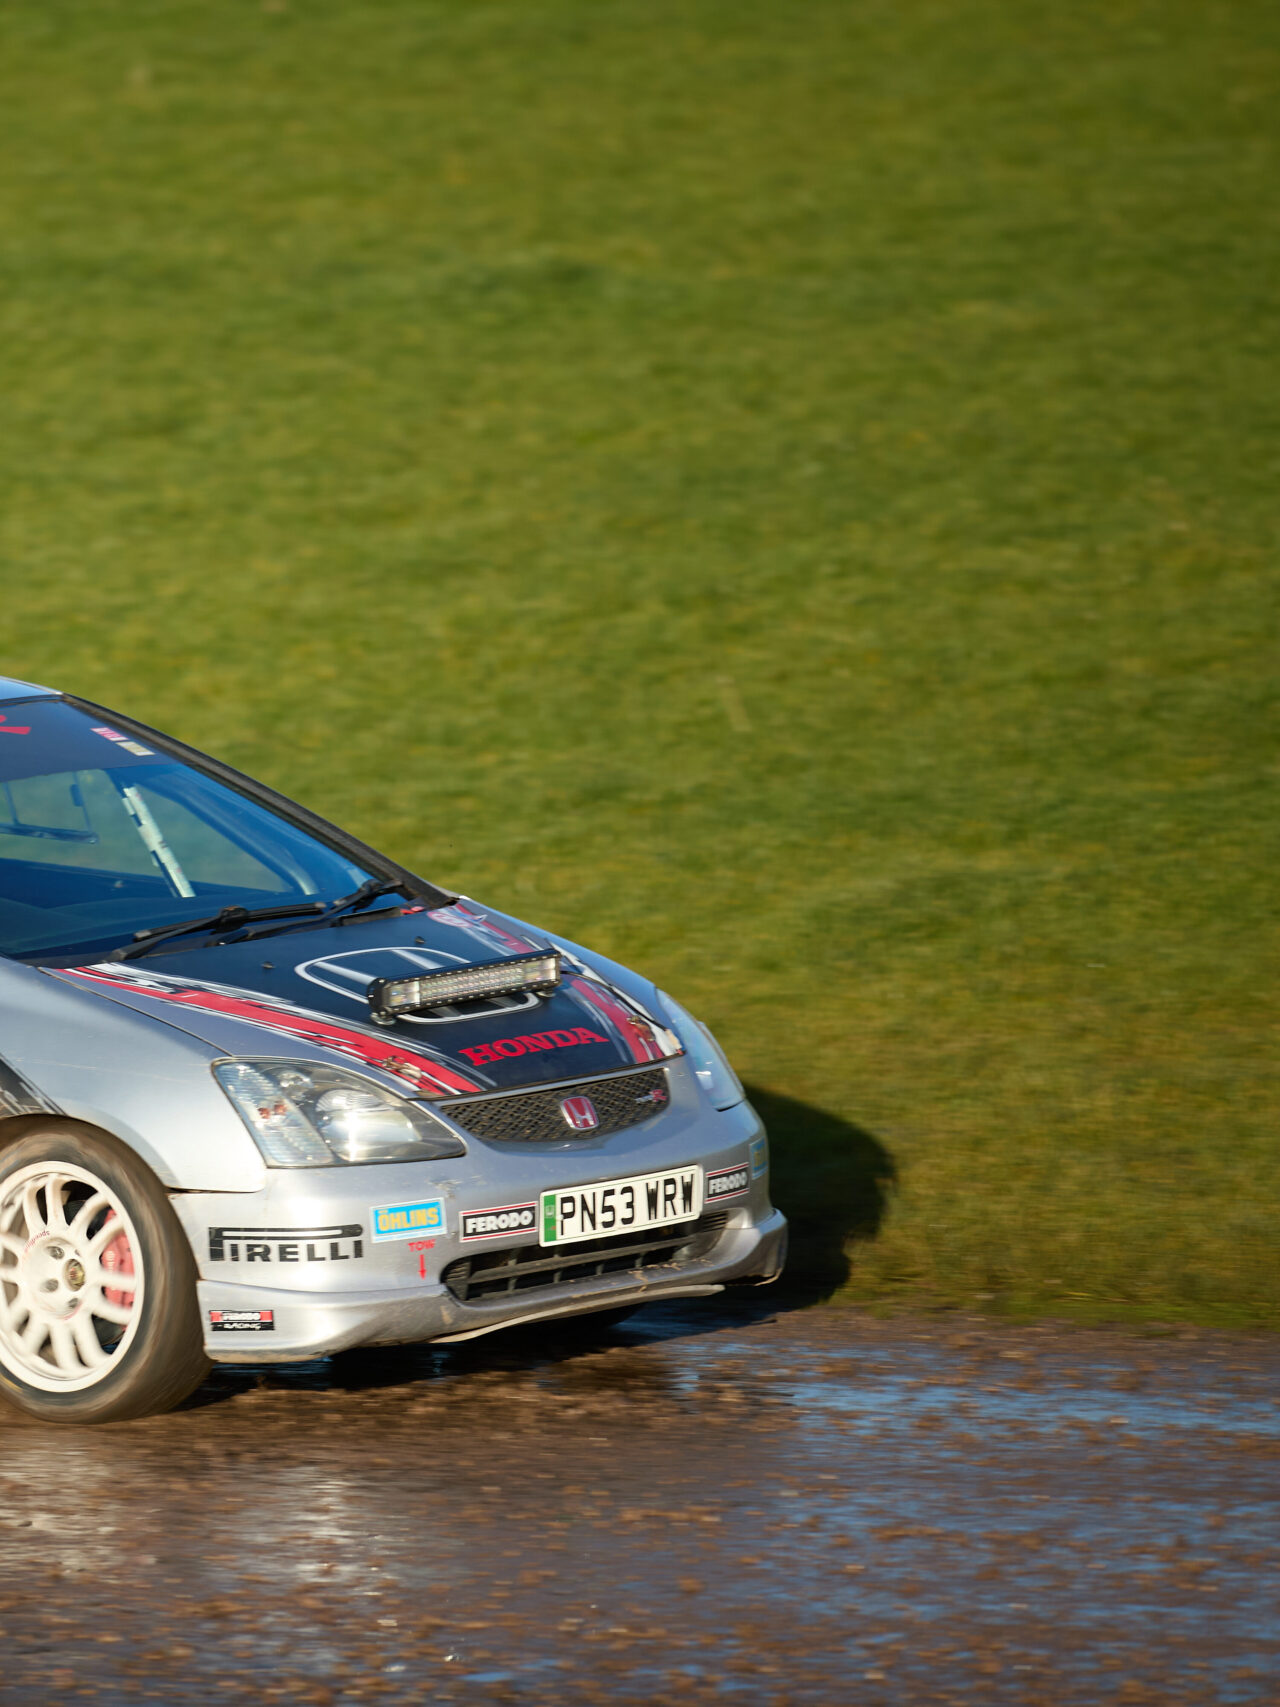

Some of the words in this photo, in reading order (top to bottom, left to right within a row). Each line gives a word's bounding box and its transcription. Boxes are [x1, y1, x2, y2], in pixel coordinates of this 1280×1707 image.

[458, 1027, 610, 1066] HONDA
[708, 1171, 747, 1194] FERODO
[560, 1186, 635, 1236] PN53
[646, 1173, 695, 1222] WRW
[378, 1207, 439, 1231] ÖHLINS
[465, 1210, 533, 1233] FERODO
[208, 1224, 363, 1262] PIRELLI
[408, 1239, 436, 1252] TOW
